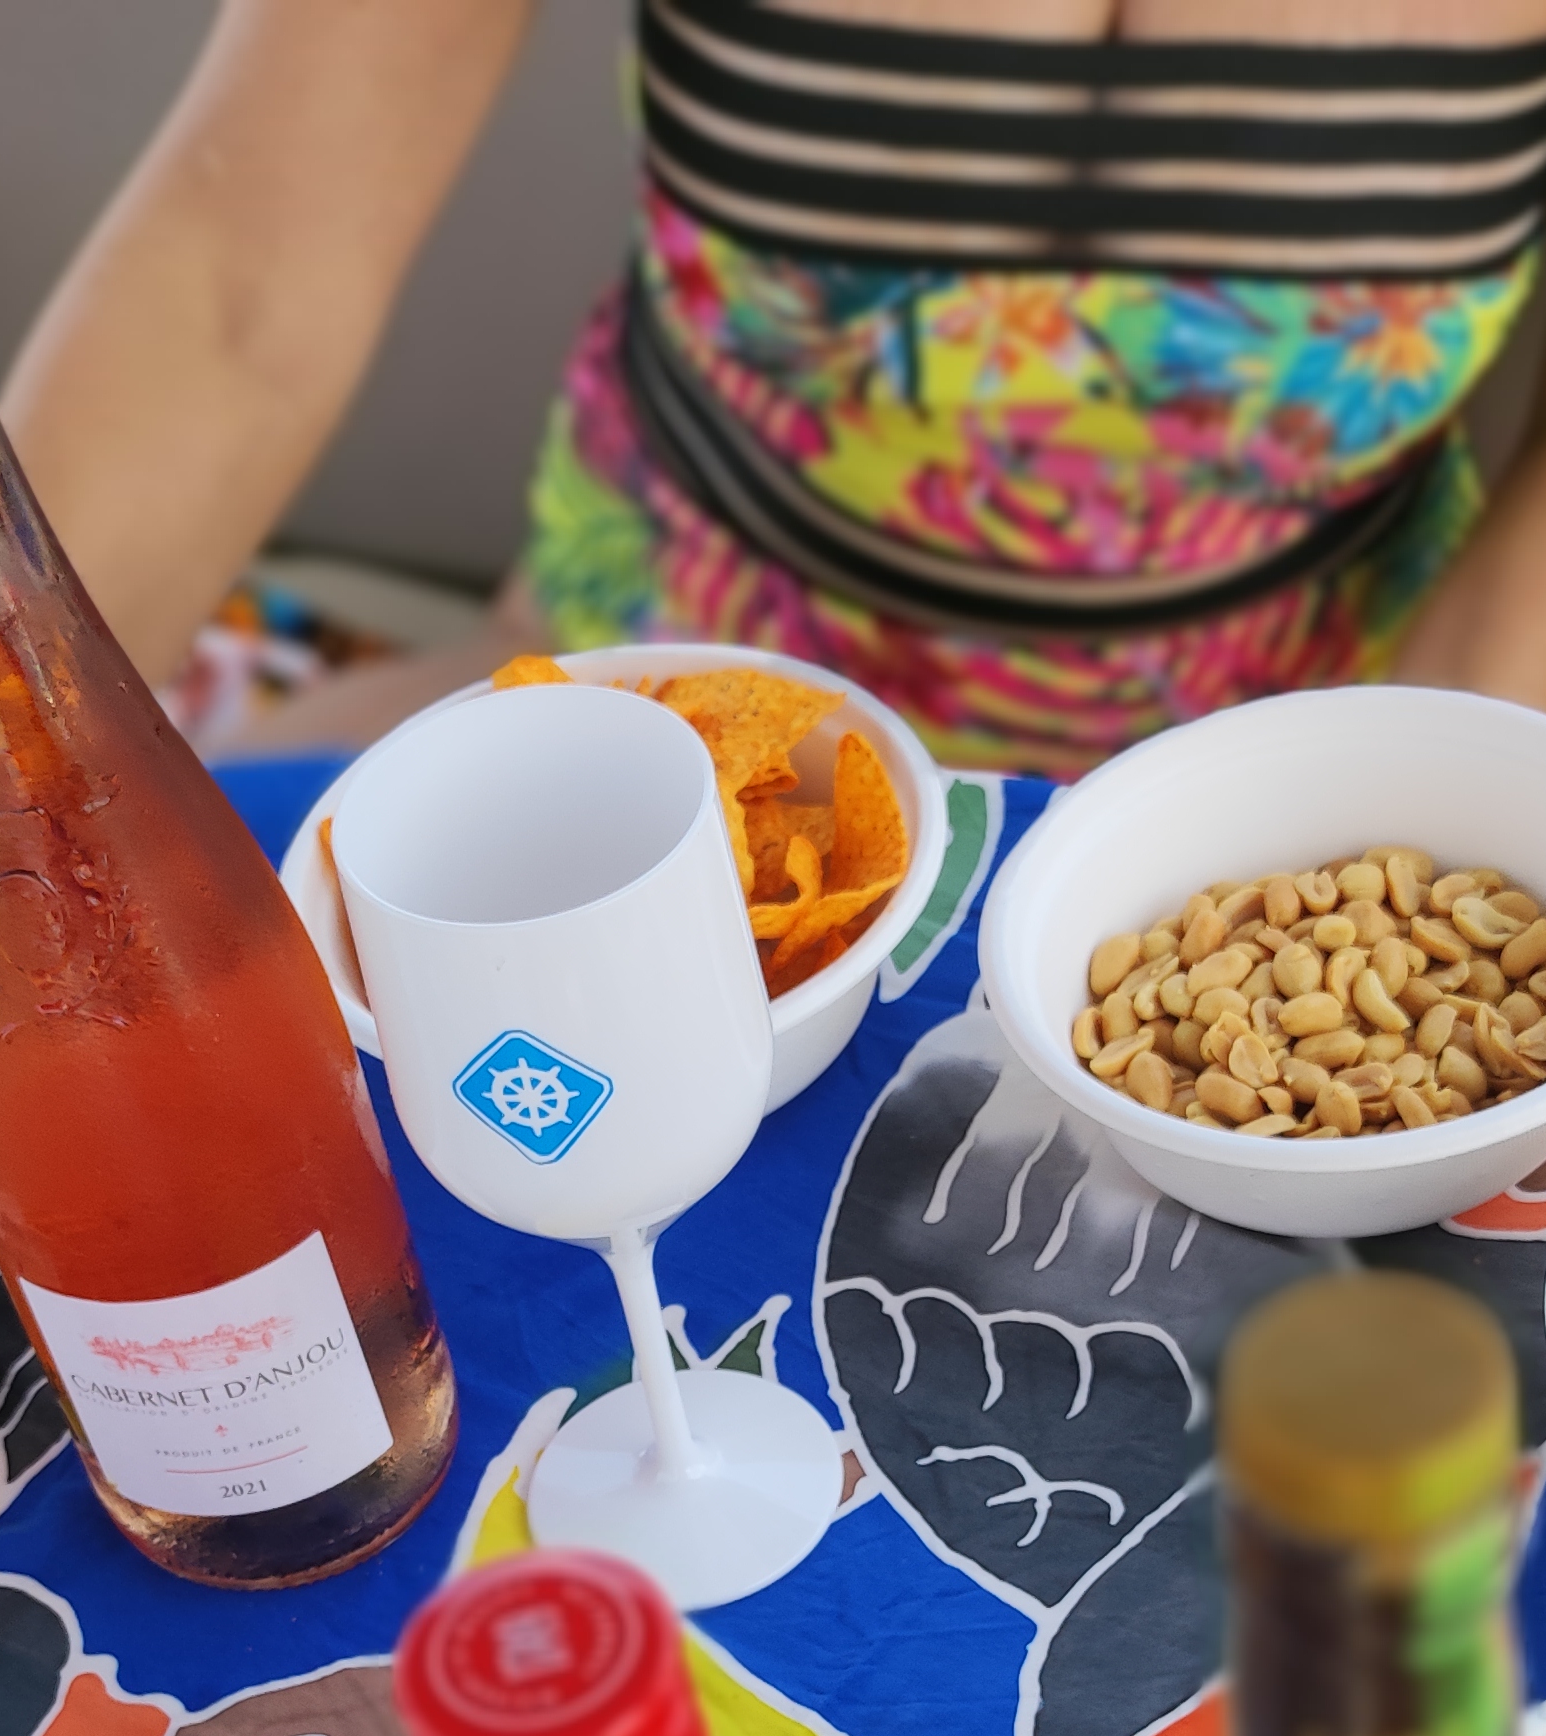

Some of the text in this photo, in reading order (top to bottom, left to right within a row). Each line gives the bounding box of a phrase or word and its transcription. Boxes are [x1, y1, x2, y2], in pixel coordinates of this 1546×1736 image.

[71, 1327, 345, 1408] CABERNET D'ANJOU
[155, 1426, 301, 1458] PRODUIT DE FRANCE
[219, 1479, 267, 1499] 2021
